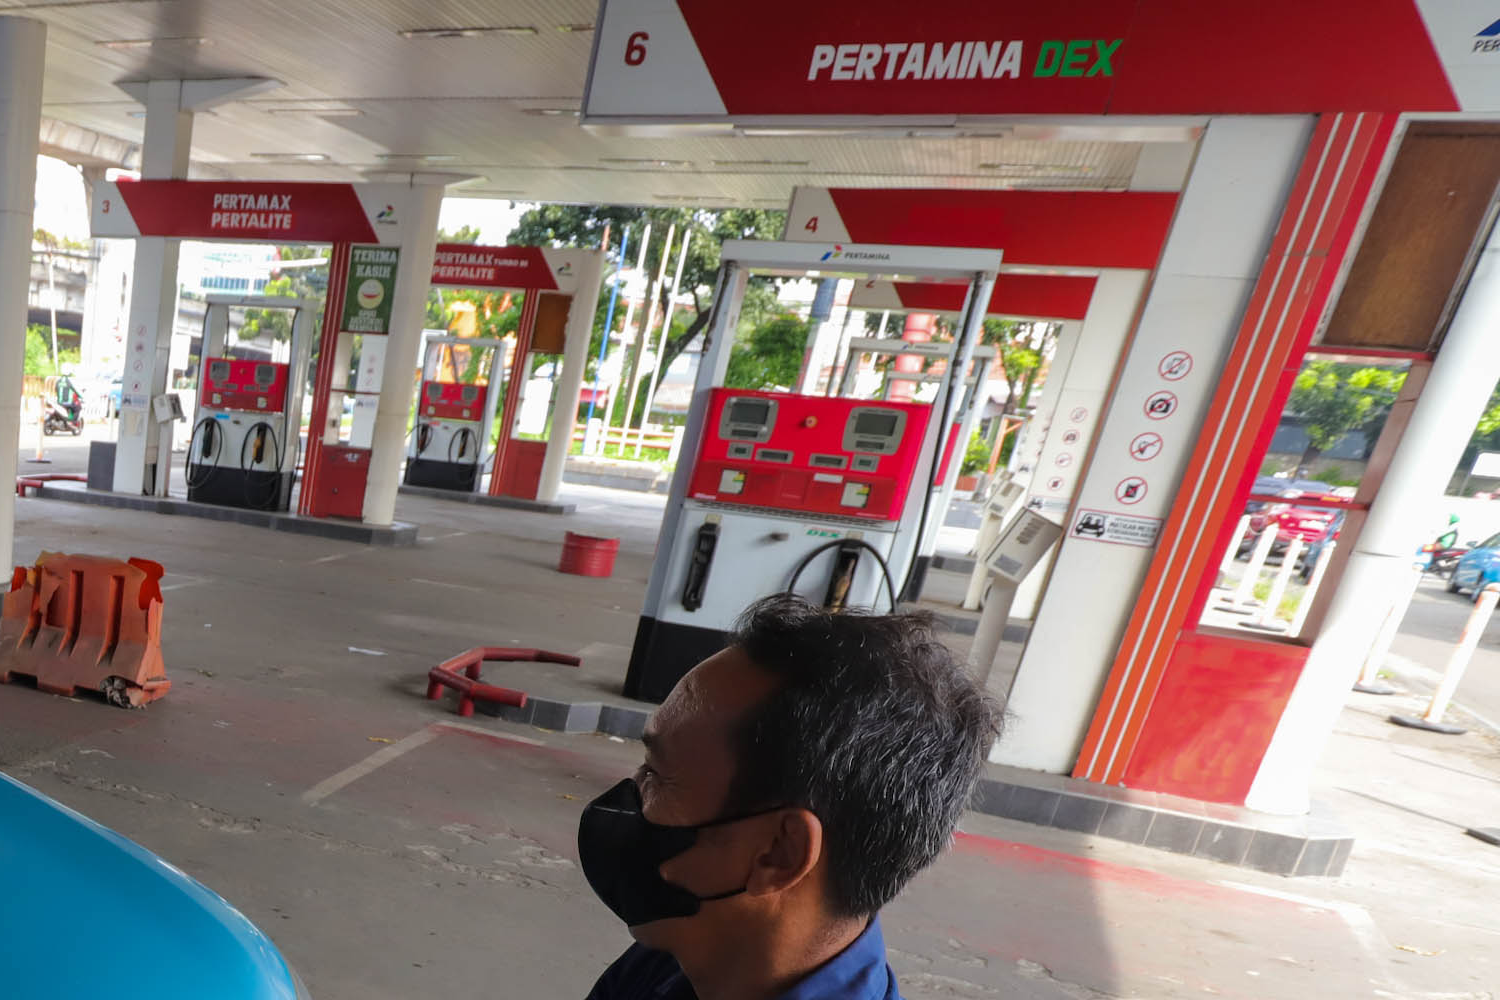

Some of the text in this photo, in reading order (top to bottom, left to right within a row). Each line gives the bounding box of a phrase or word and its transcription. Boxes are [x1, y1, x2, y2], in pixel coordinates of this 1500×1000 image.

[624, 31, 649, 66] 6
[807, 38, 1123, 81] PERTAMINA DEX
[102, 201, 110, 213] 3
[213, 194, 291, 210] PERTAMAX
[211, 211, 292, 229] PERTALITE
[804, 216, 818, 233] 4
[353, 249, 398, 264] TERIMA
[432, 265, 495, 280] PERTALITE
